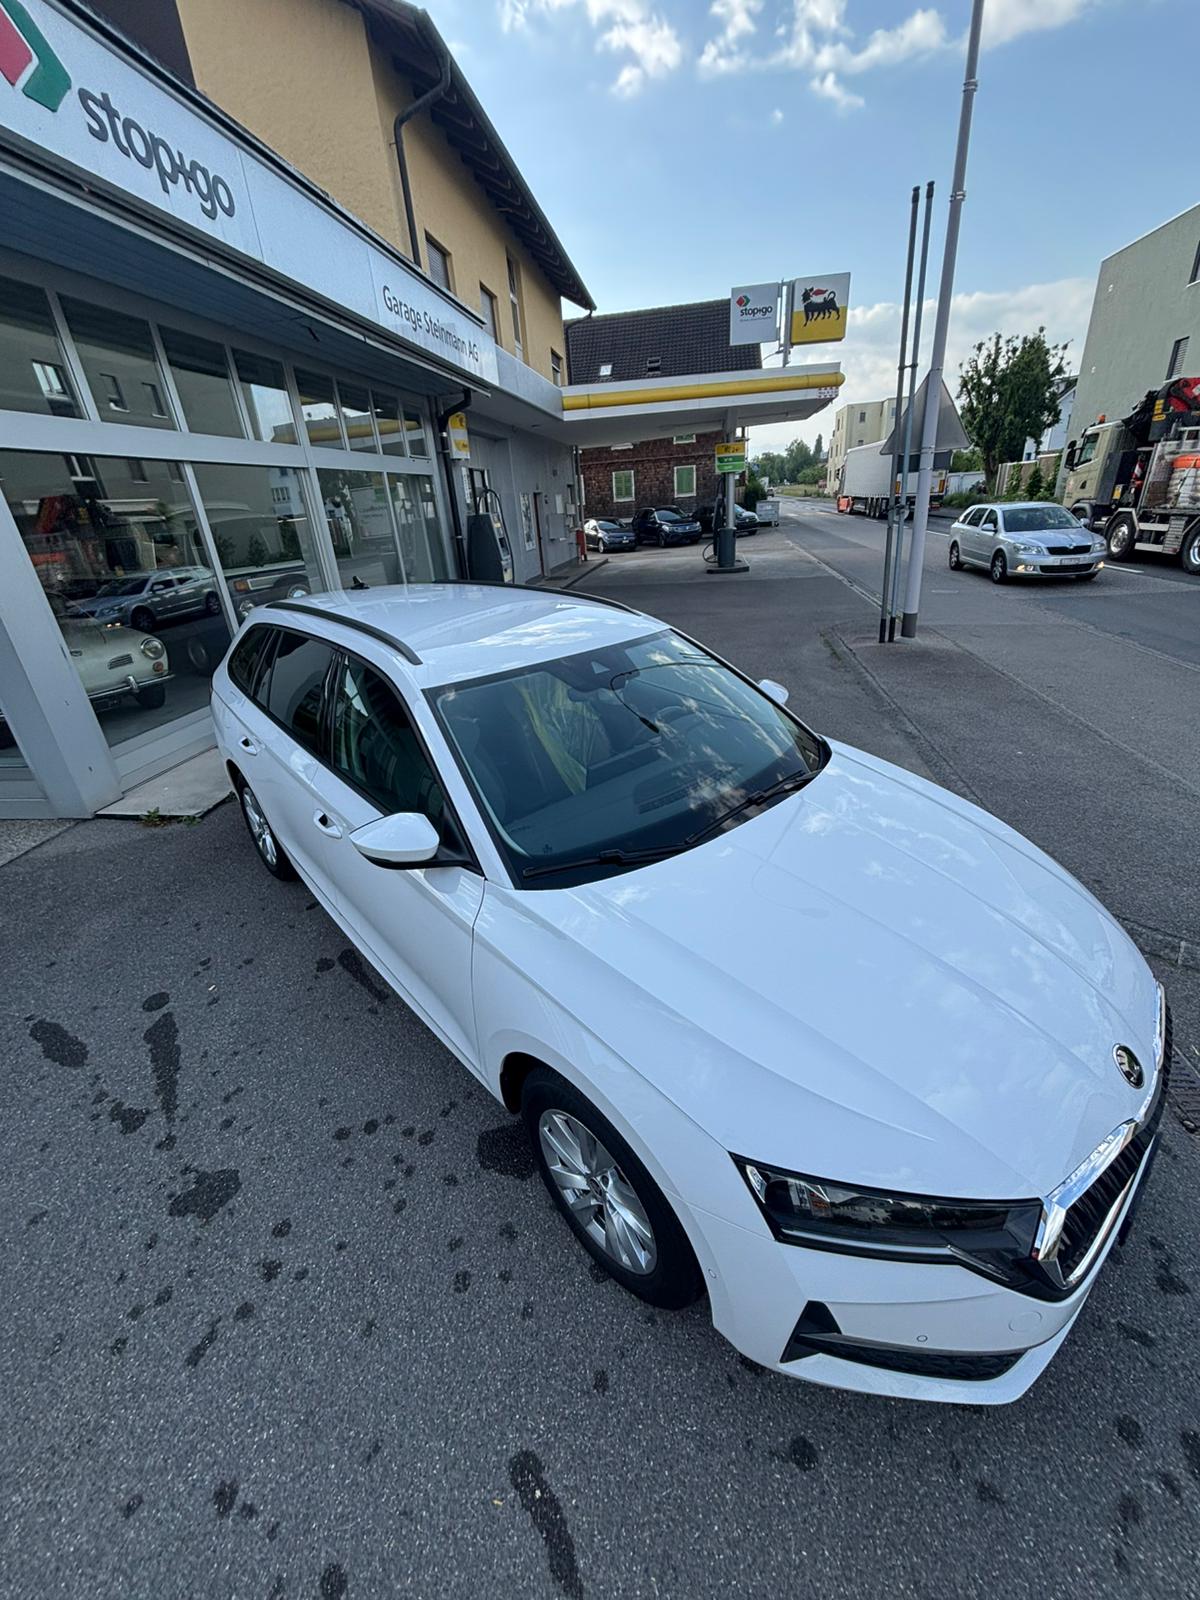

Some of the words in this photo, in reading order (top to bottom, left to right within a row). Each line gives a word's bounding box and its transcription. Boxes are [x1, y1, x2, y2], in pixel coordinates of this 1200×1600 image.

[78, 87, 235, 220] stop+go
[383, 285, 422, 332] Garage
[423, 311, 467, 356] Steinmann
[468, 340, 479, 362] AG
[740, 305, 773, 317] stop+go
